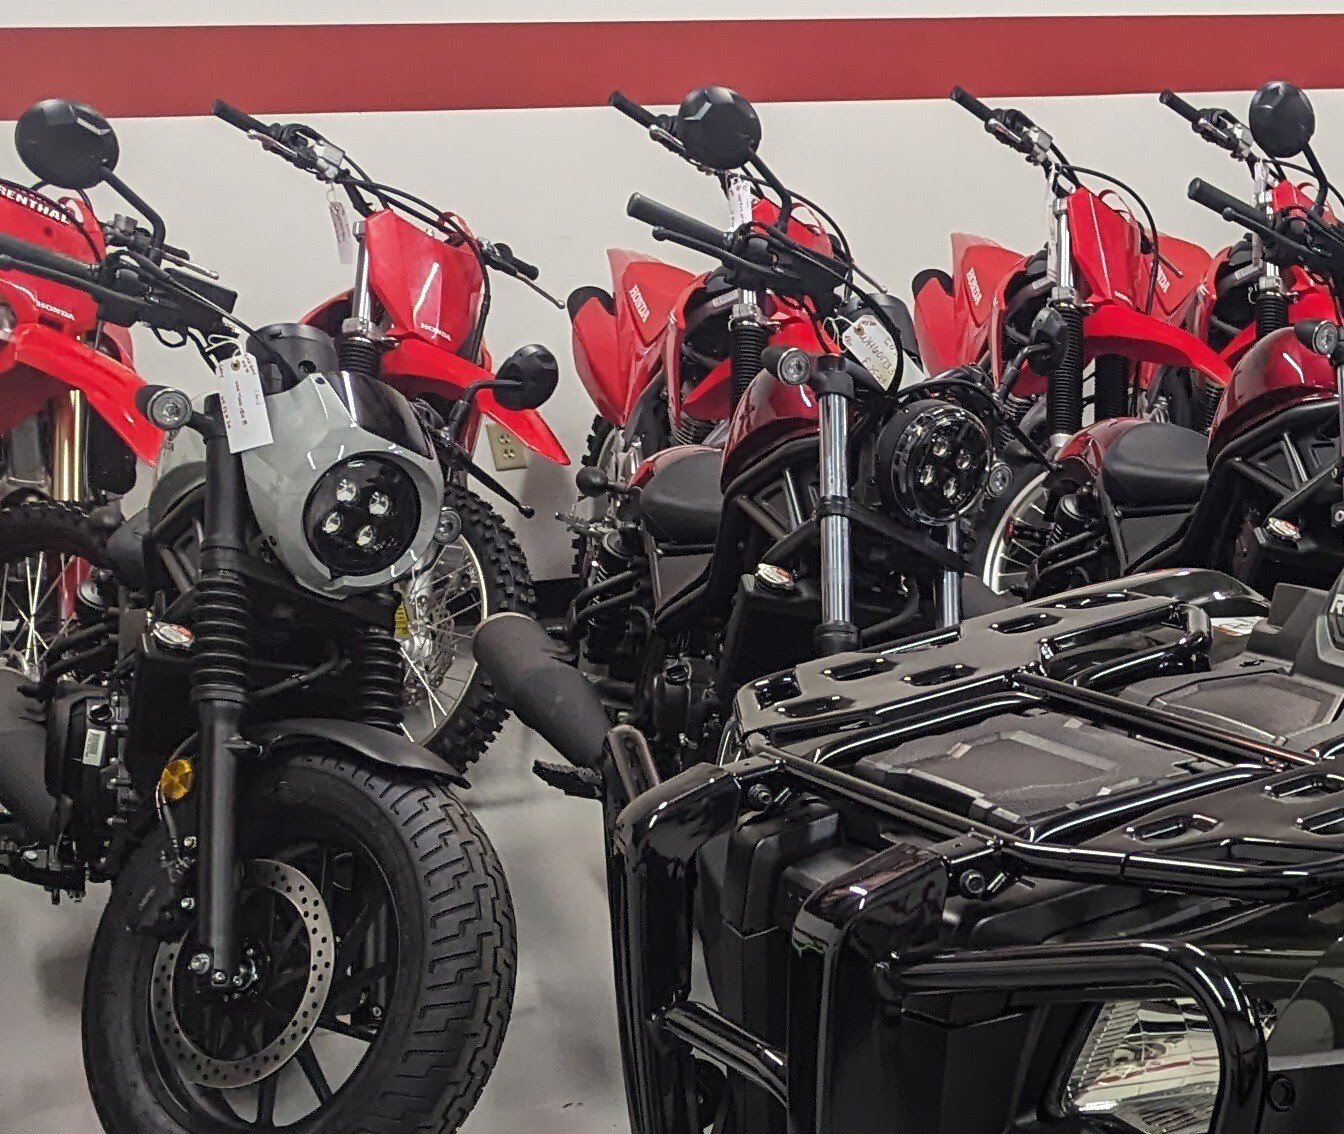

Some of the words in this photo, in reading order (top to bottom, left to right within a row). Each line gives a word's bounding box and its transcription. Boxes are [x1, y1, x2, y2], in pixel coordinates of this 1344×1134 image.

[629, 284, 651, 323] HONDA
[966, 267, 983, 306] HONDA
[36, 301, 76, 322] HONDA
